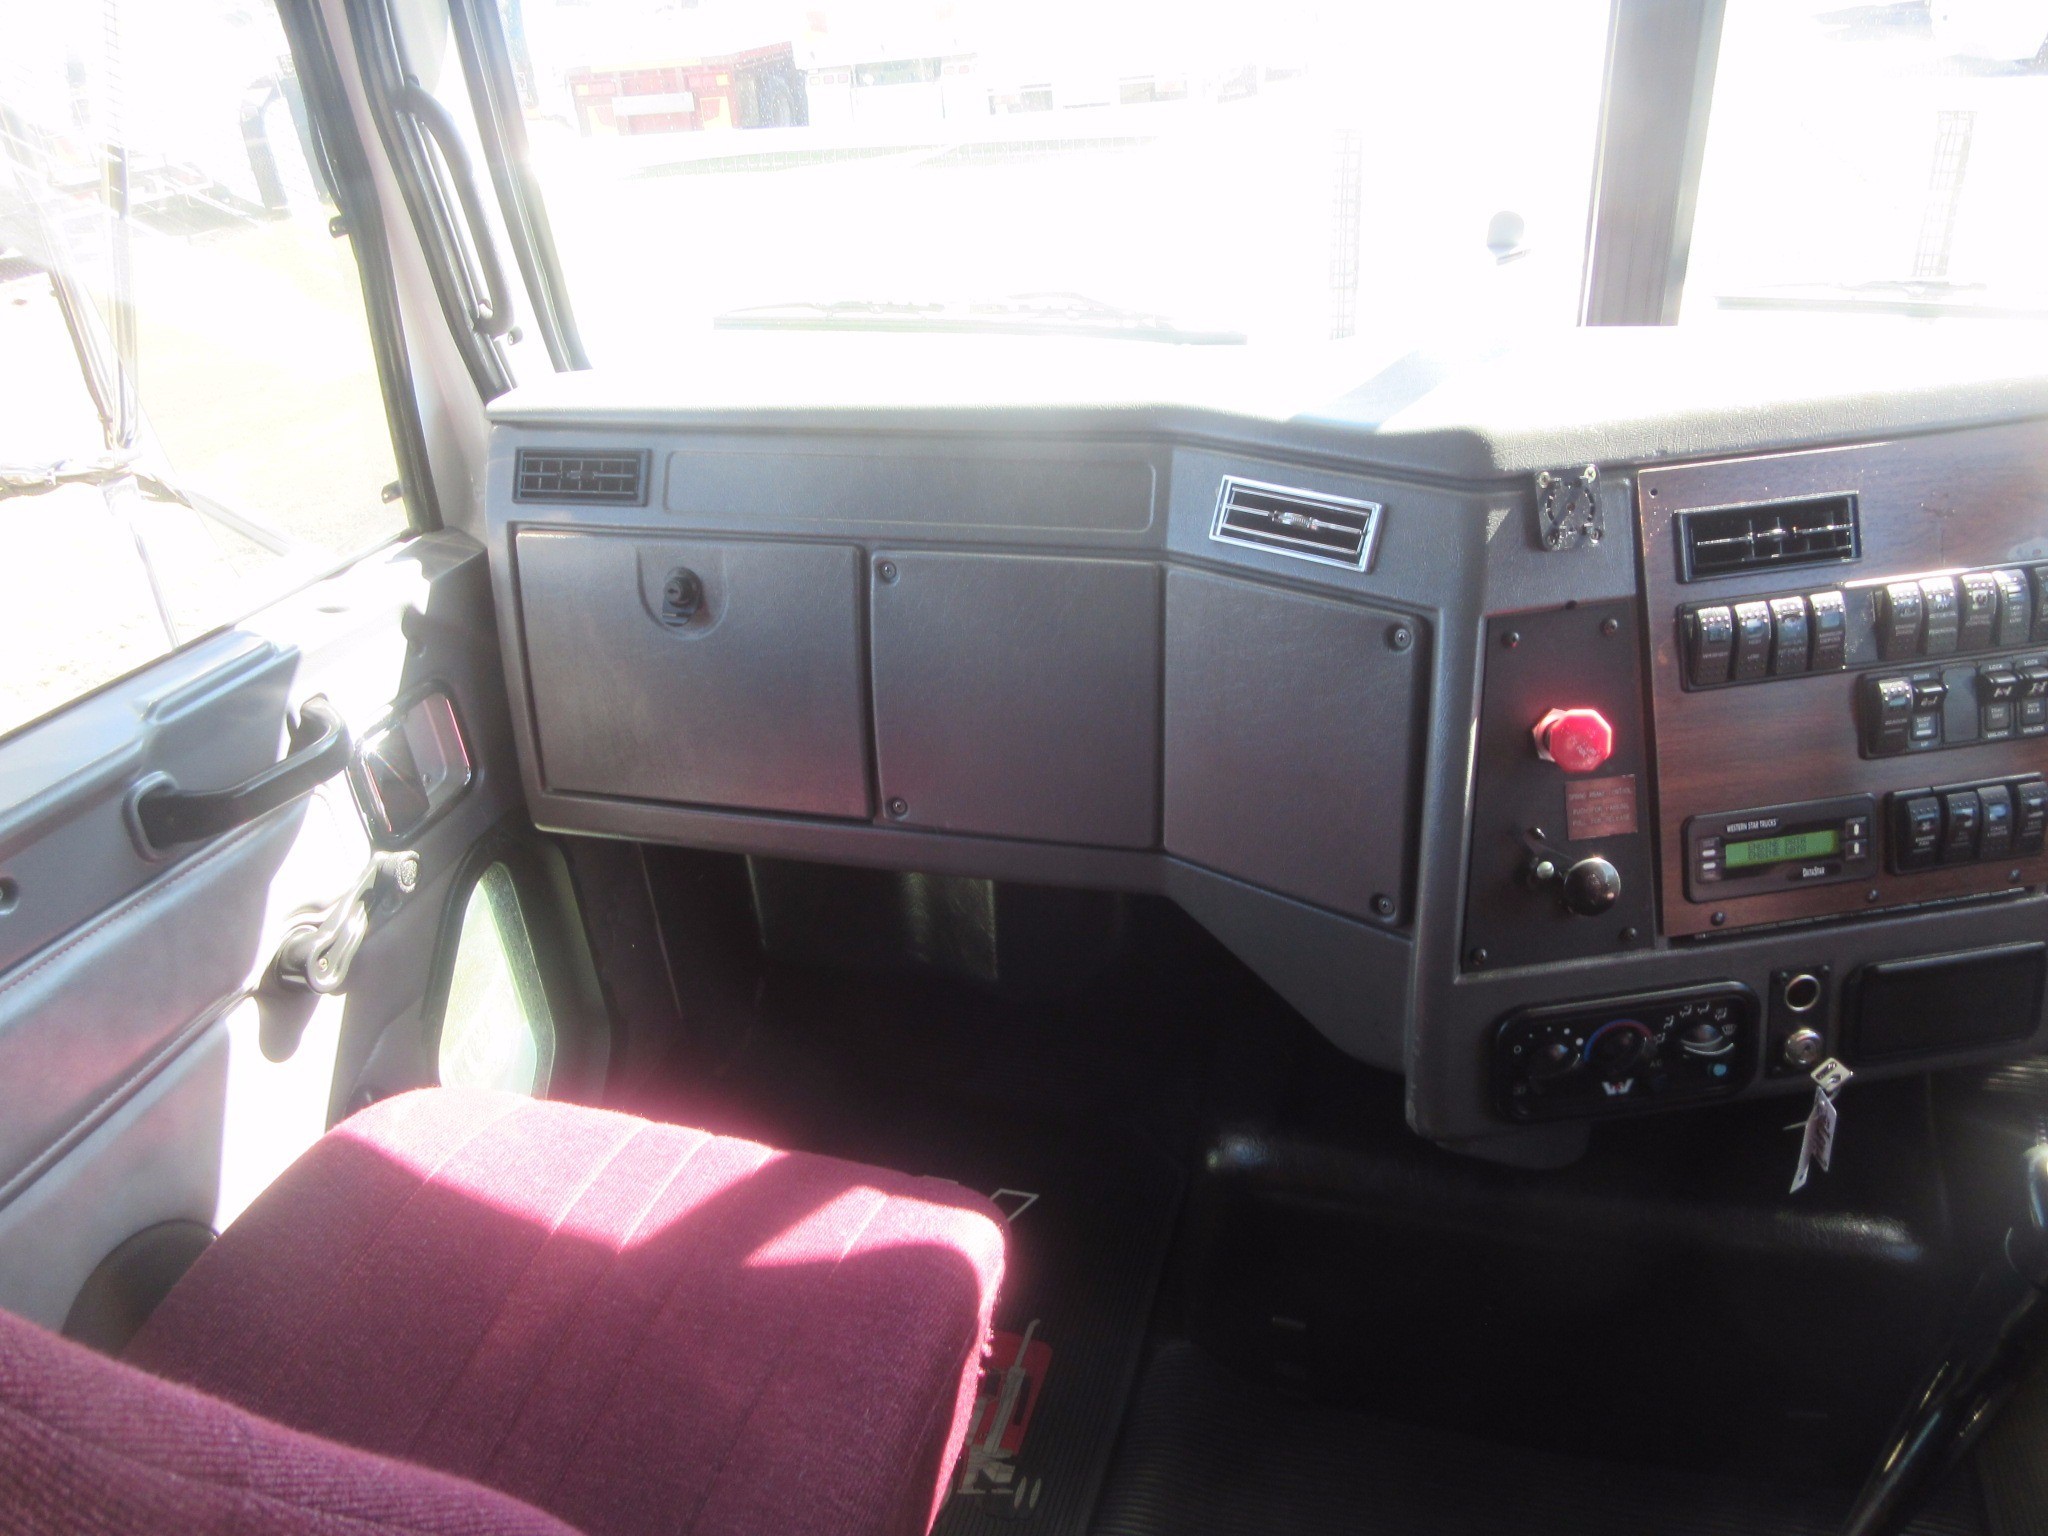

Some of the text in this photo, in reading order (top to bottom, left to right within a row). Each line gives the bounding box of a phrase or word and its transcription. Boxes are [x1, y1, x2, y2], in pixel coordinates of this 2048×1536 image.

[1726, 818, 1777, 833] WESTERN STAR TRUCKS
